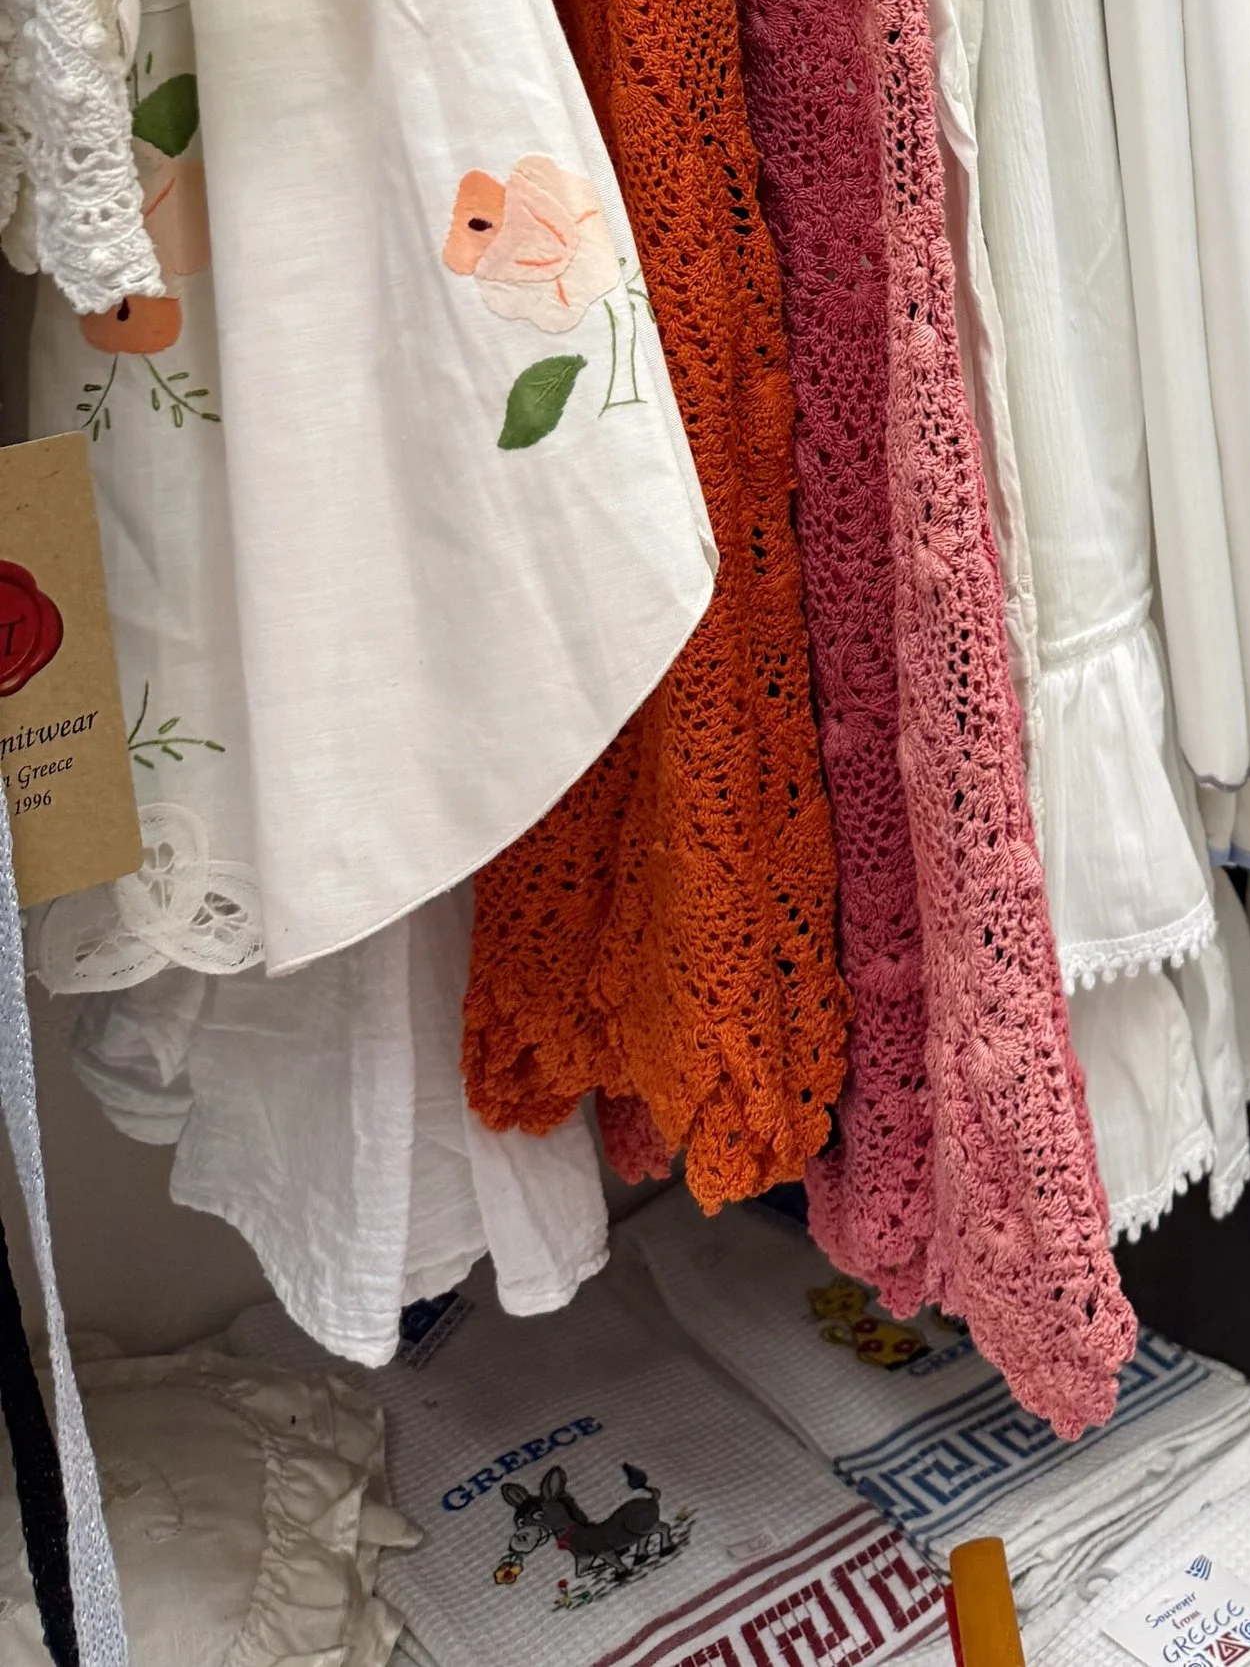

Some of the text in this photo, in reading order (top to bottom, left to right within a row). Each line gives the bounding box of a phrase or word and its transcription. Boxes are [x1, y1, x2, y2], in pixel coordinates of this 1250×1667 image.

[0, 710, 98, 761] nitwear
[18, 756, 73, 789] Greece
[15, 789, 52, 816] 1996
[441, 1416, 603, 1511] GREECE
[1145, 1591, 1197, 1629] Souvenir
[1162, 1598, 1245, 1663] GREECE
